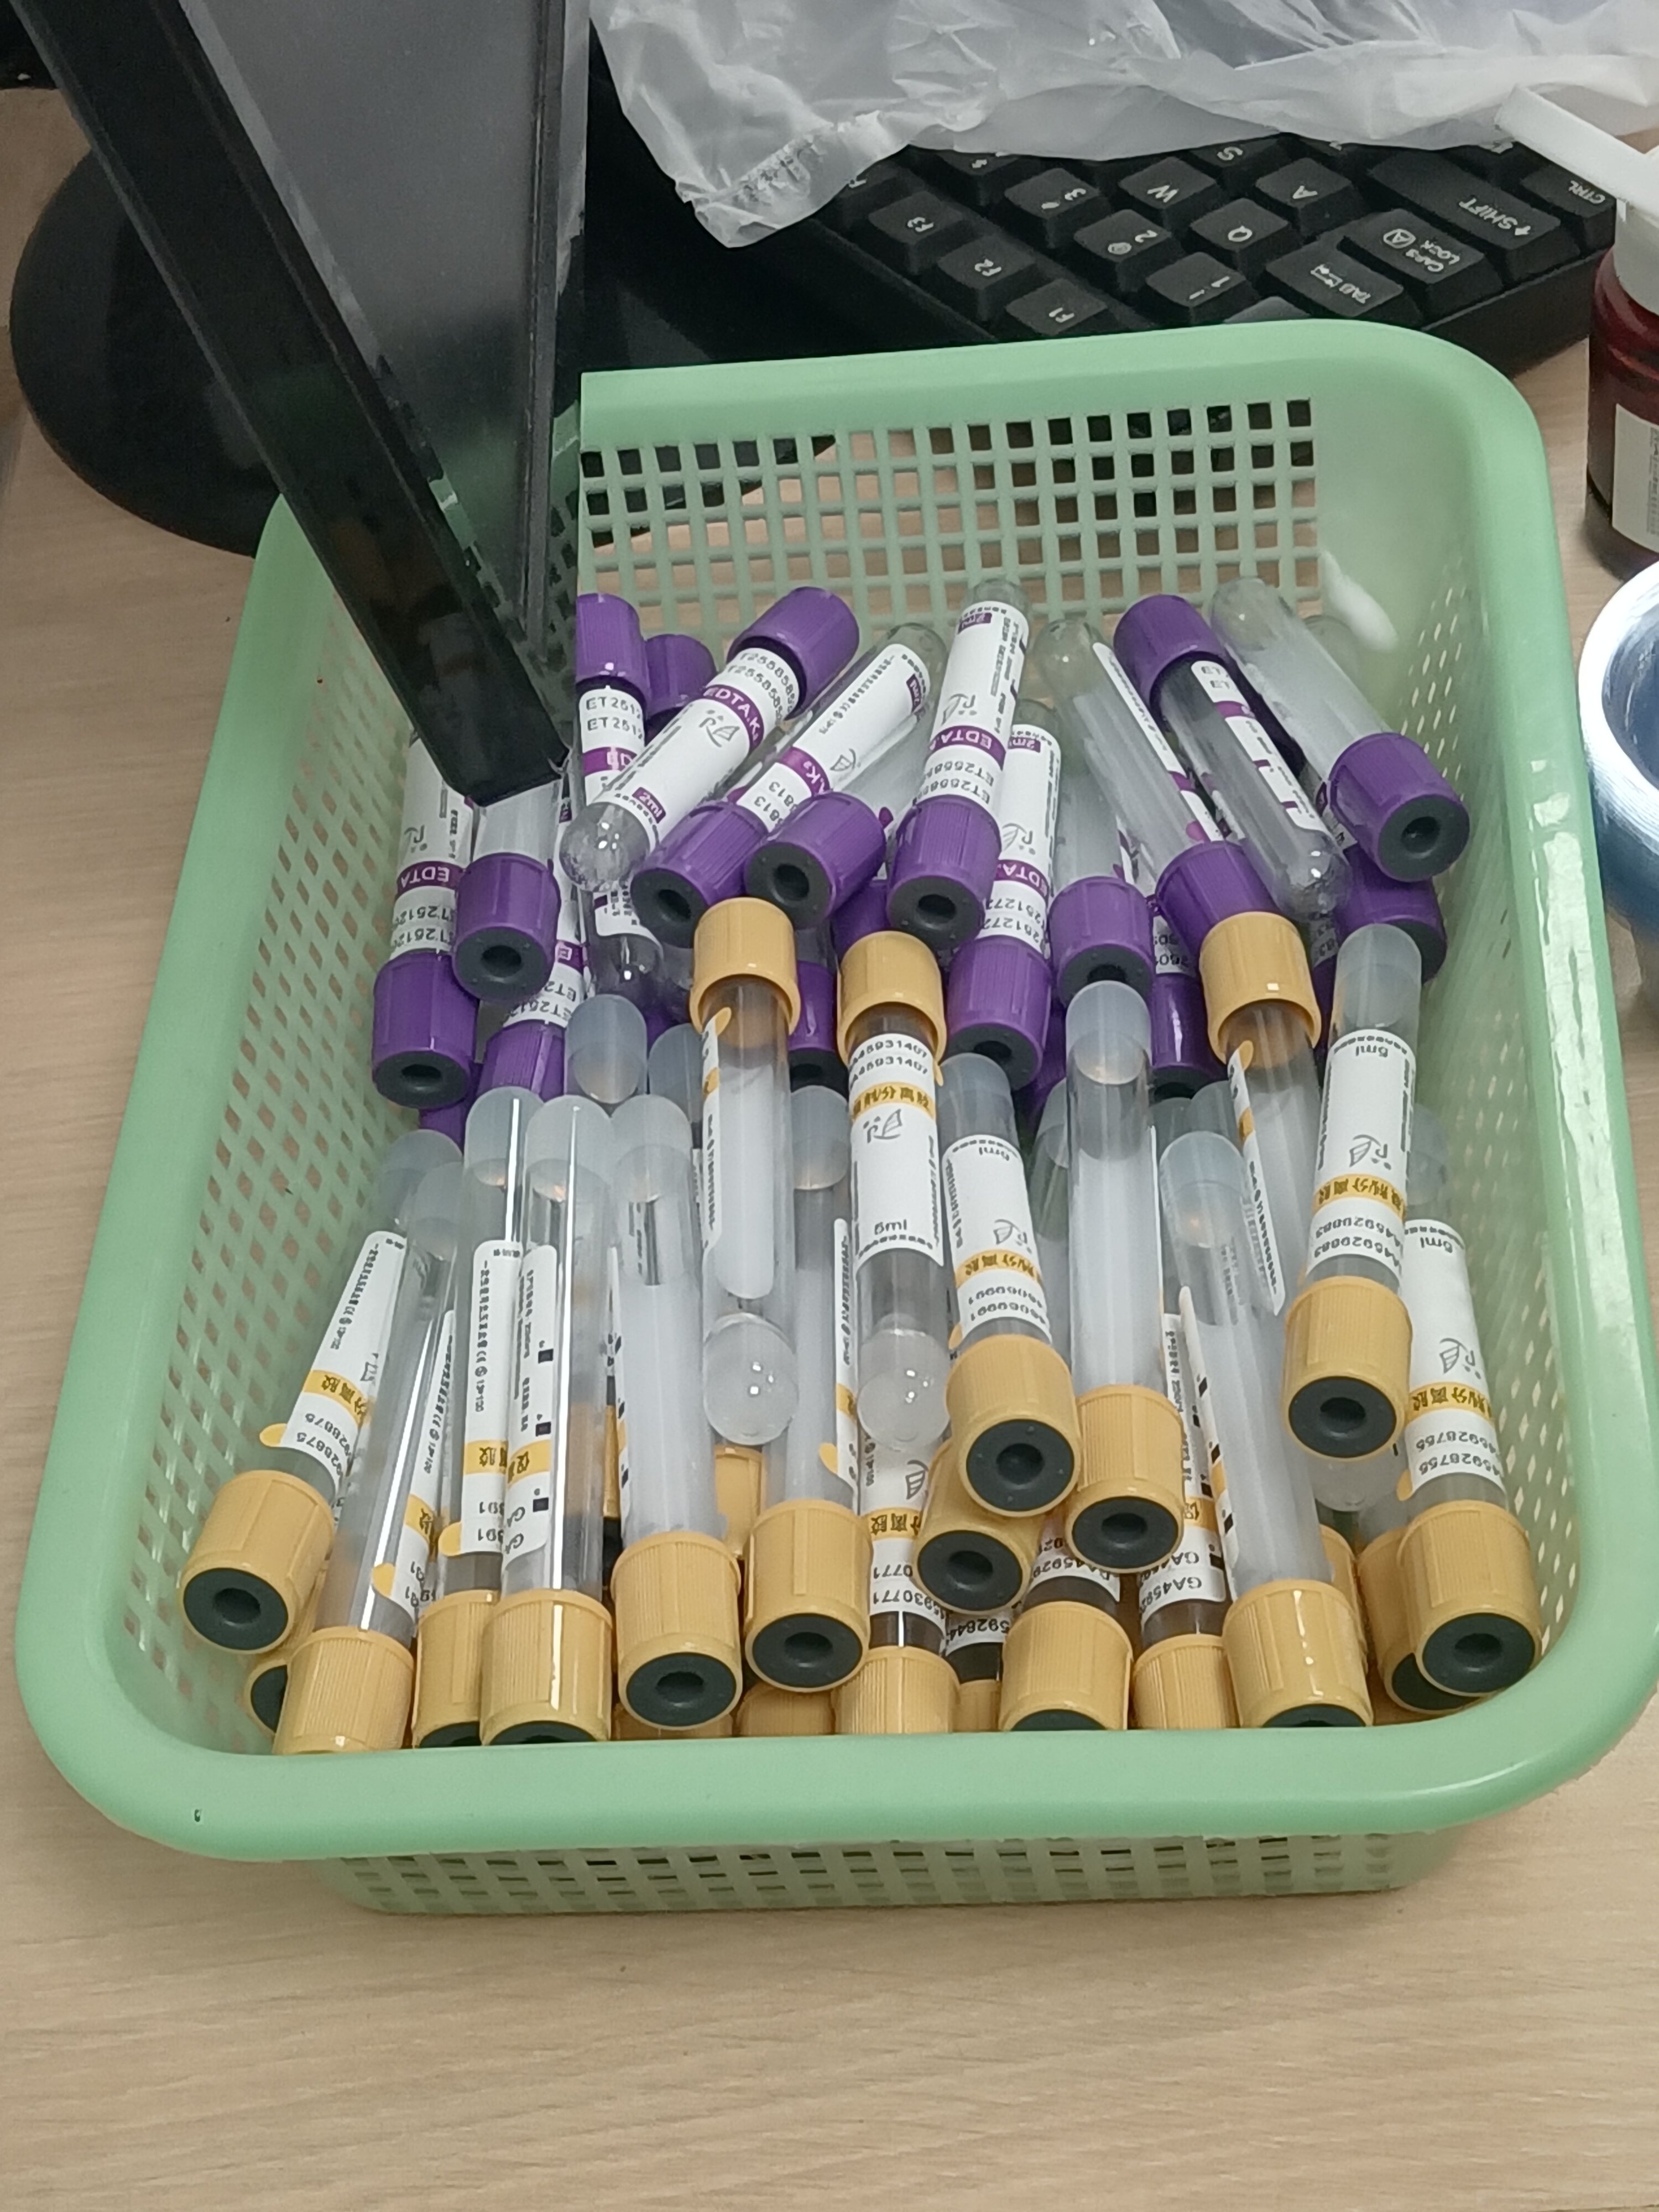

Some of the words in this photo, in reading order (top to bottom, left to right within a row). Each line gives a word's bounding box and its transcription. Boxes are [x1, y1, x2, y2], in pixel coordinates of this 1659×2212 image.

[1218, 148, 1242, 160] S
[1147, 185, 1178, 203] W
[1293, 186, 1318, 199] A
[1459, 196, 1519, 232] SHIFT
[907, 217, 933, 232] F3
[1135, 229, 1158, 243] 2
[974, 259, 1002, 276] F2
[1048, 307, 1074, 323] F1
